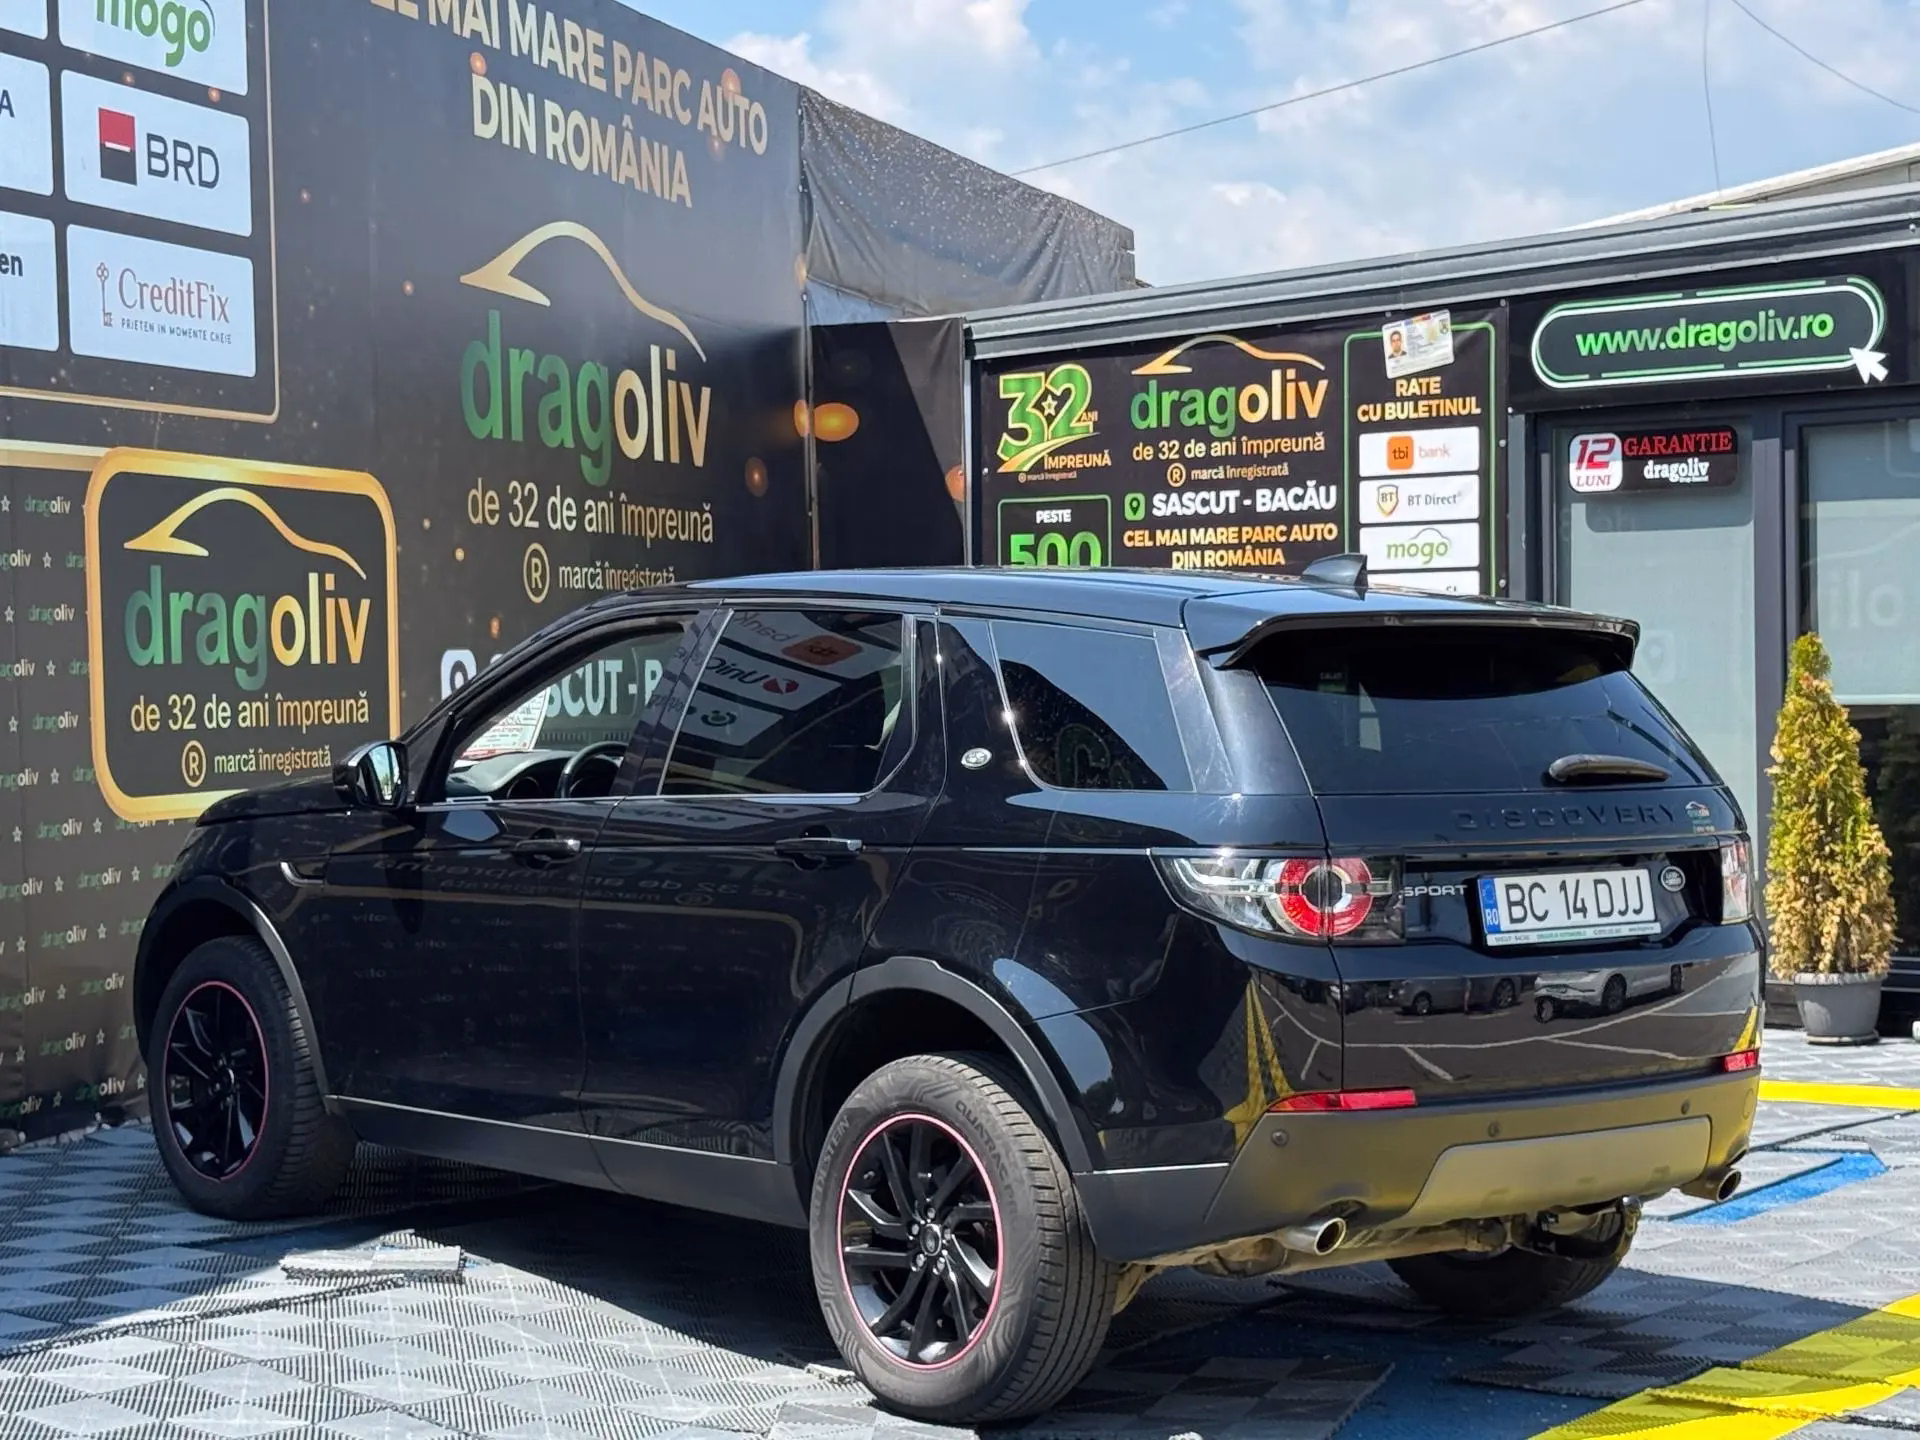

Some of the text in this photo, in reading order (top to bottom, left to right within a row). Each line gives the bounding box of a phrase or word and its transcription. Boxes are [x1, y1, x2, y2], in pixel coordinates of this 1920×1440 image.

[508, 3, 607, 92] MARE
[612, 40, 691, 125] PARC
[697, 79, 768, 155] AUTO
[472, 73, 693, 208] DIN ROMÂNIA
[146, 132, 219, 189] BRD
[118, 268, 229, 323] CreditFix
[121, 317, 154, 333] PRIETEN
[157, 323, 167, 334] IN
[169, 325, 207, 341] MOMENTE
[1575, 308, 1835, 357] www.dragoliv.ro
[460, 309, 711, 487] dragoliv
[1395, 376, 1442, 397] RATE
[997, 364, 1092, 461] 32
[1130, 368, 1329, 438] dragoliv
[1357, 396, 1481, 423] CU BULETINUL
[1043, 449, 1113, 470] ÎMPREUNĂ
[1132, 432, 1326, 462] de 32 de ani împreună
[1391, 444, 1451, 461] tbi bank
[1575, 430, 1733, 471] 12 GARANTIE
[1191, 465, 1224, 481] marcă
[1226, 462, 1289, 481] înregistrată
[1575, 457, 1710, 488] LUNI dragoliv
[468, 478, 714, 548] de 32 de ani împreună
[1152, 488, 1241, 518] SASCUT
[1255, 479, 1337, 513] BACĂU
[1407, 494, 1421, 507] BT
[1424, 492, 1457, 506] Direct
[1035, 508, 1072, 525] PESTE
[1010, 531, 1102, 567] 500
[1123, 522, 1339, 548] CEL MAI MARE PARC AUTO
[1171, 546, 1285, 569] DIN ROMÂNIA
[1385, 540, 1449, 565] mogo
[559, 560, 603, 590] marcă
[124, 564, 371, 691] dragoliv
[131, 690, 370, 734] de 32 de ani împreună
[214, 749, 256, 775] marcă
[258, 745, 332, 776] înregistrată
[1453, 803, 1677, 830] DISCOVERY
[1403, 884, 1468, 898] SPORT
[1505, 875, 1644, 925] BC 14 DJJ
[1485, 908, 1500, 926] RO
